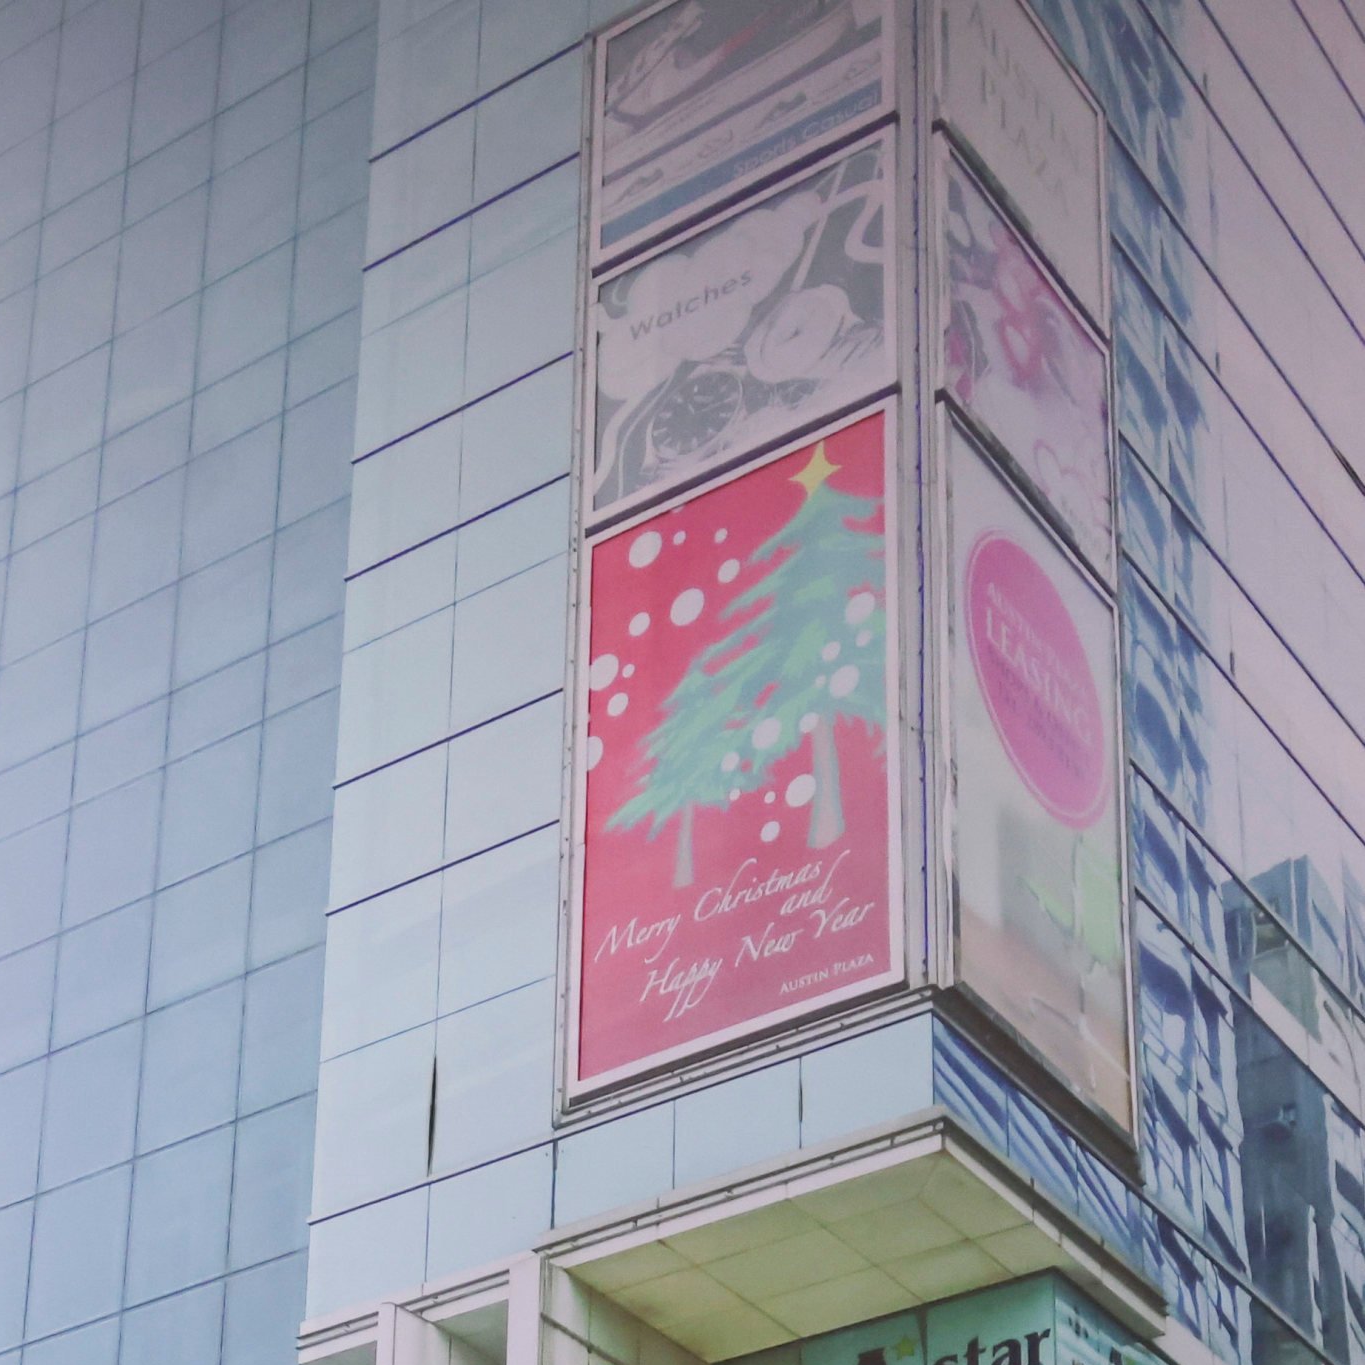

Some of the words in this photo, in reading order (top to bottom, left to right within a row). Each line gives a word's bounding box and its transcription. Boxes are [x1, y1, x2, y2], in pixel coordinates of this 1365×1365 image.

[803, 92, 879, 141] Casual
[630, 269, 753, 341] Watches
[986, 606, 1092, 744] LEASING
[595, 914, 682, 964] Merry
[694, 857, 823, 922] Christmas
[781, 849, 851, 916] and
[639, 957, 723, 1023] Happy
[735, 922, 804, 968] New
[809, 897, 875, 939] Year
[780, 968, 829, 995] AUSTIN
[833, 953, 874, 975] PLAZA
